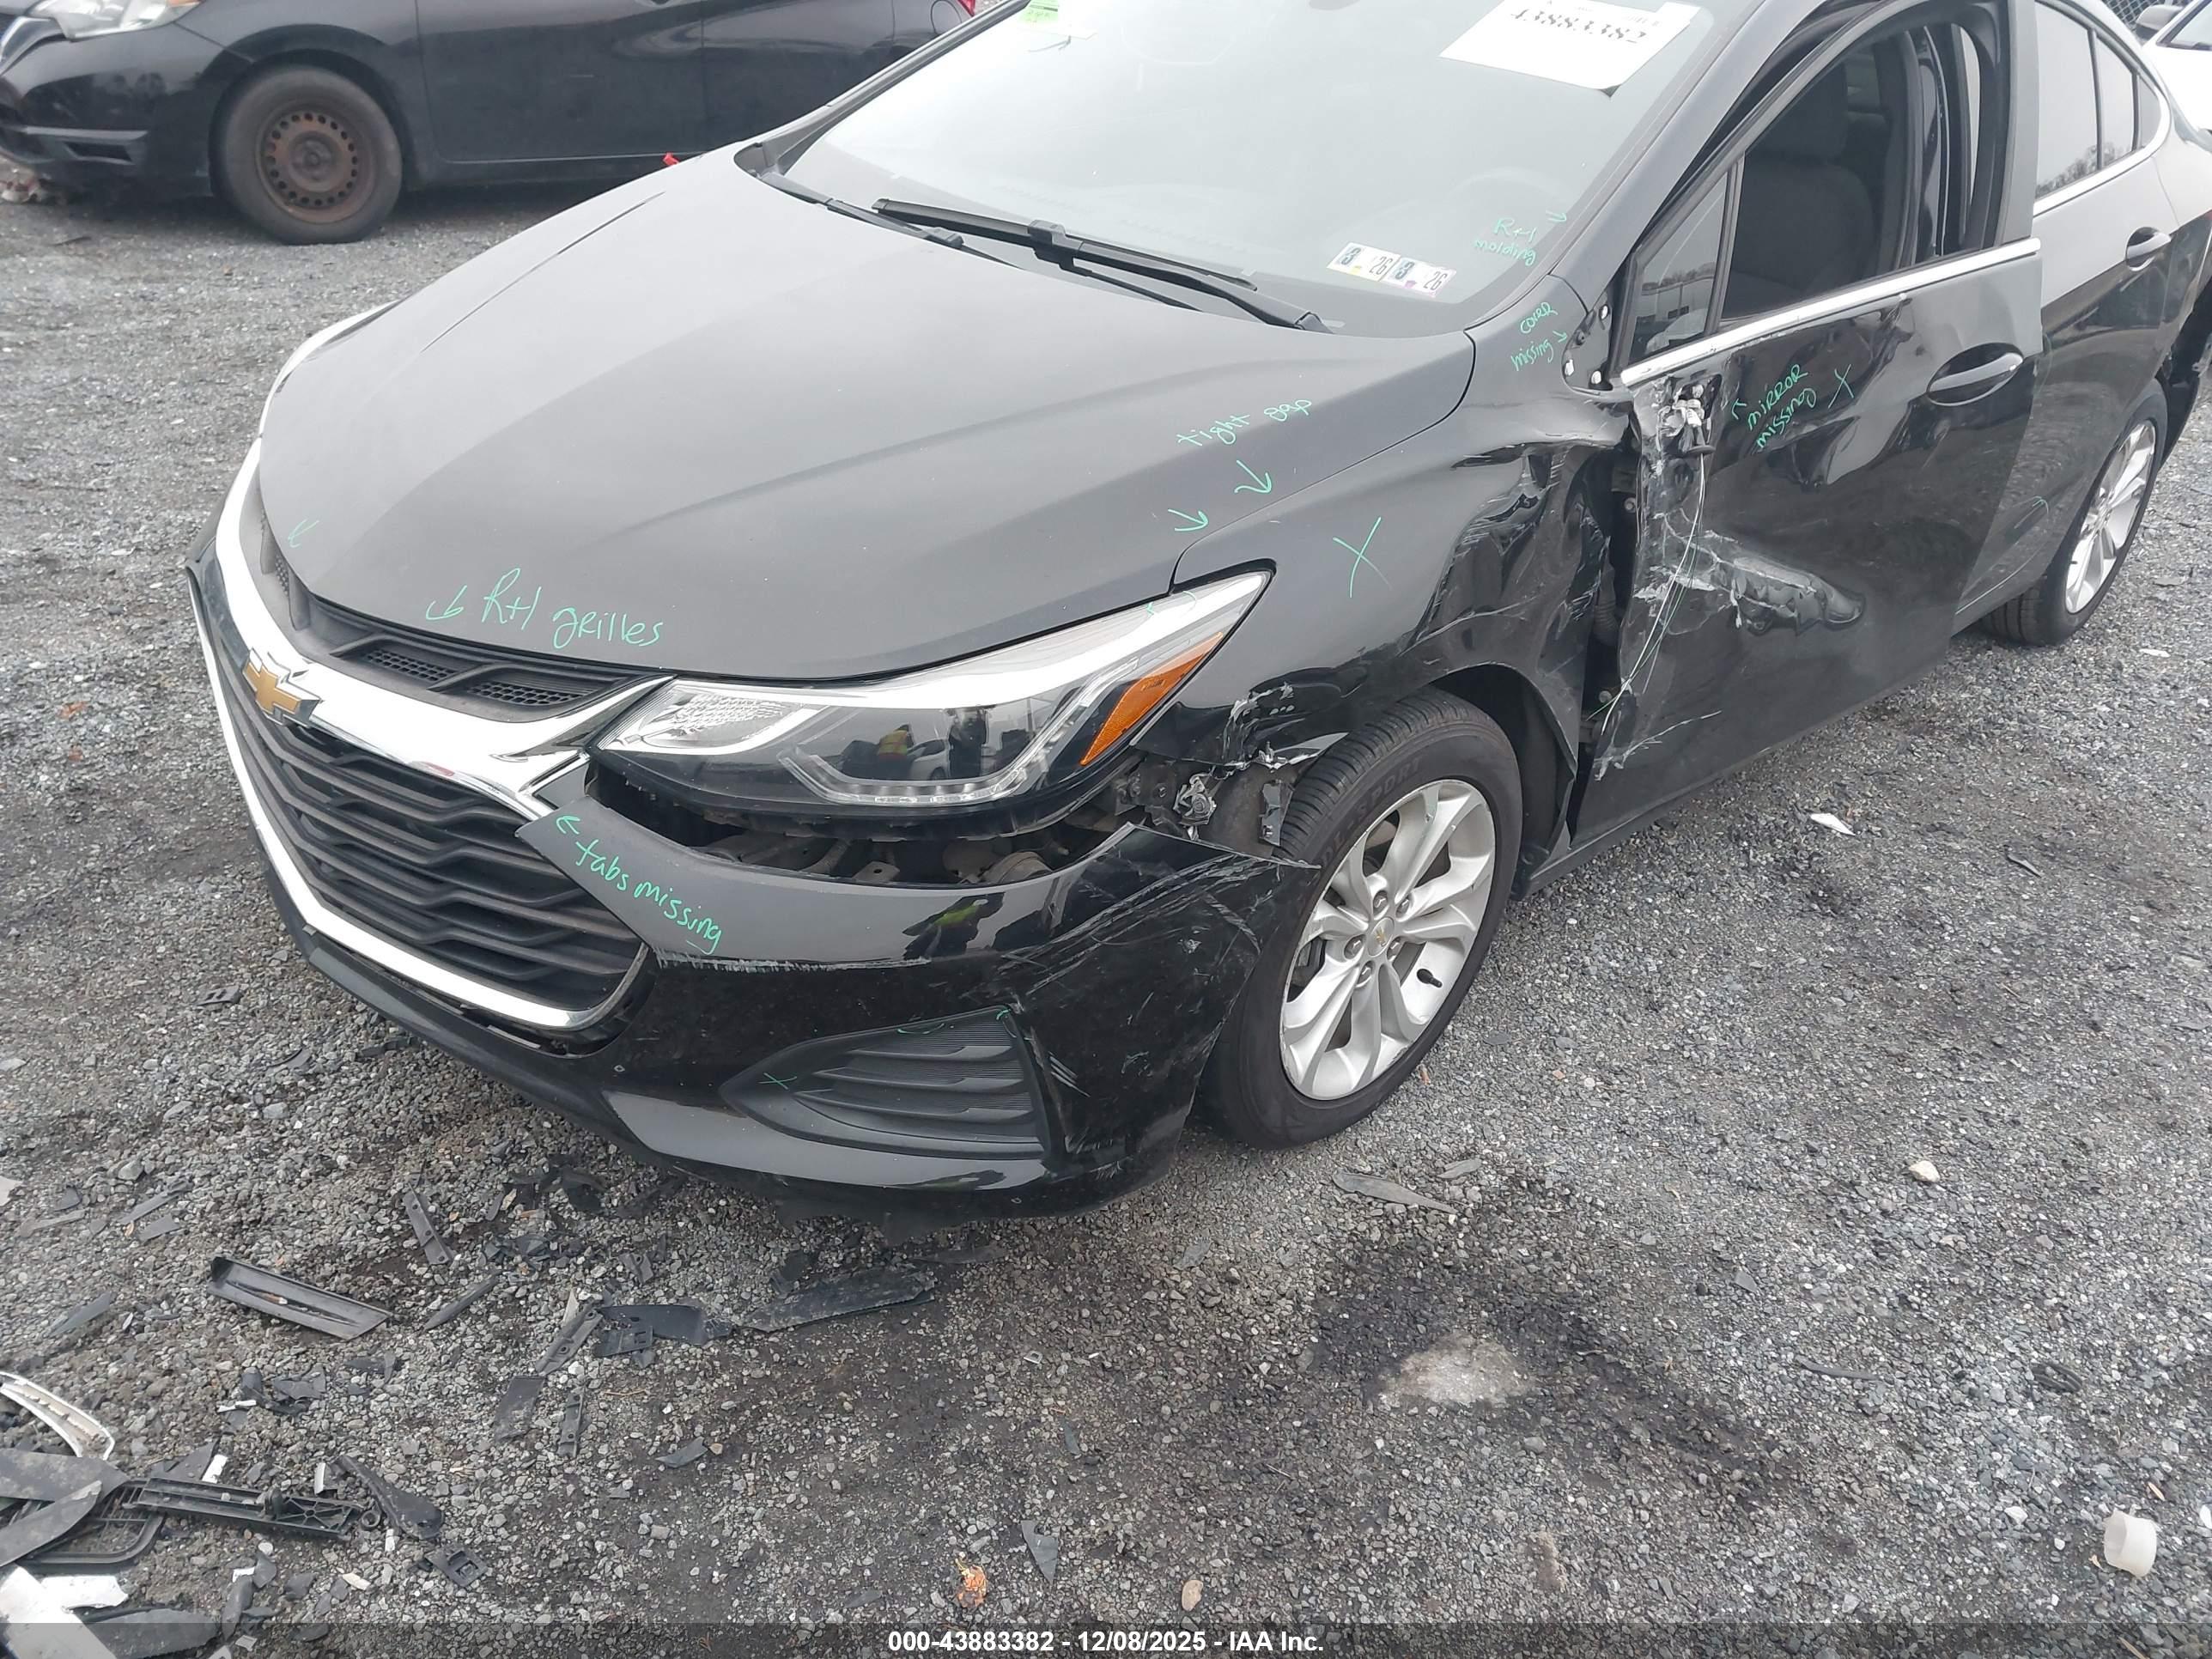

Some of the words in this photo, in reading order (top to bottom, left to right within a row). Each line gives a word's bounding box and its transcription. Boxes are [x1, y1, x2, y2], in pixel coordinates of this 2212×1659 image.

[1369, 256, 1394, 276] 26
[1474, 239, 1536, 266] molding
[1423, 270, 1449, 291] 26
[1510, 339, 1554, 371] missing
[1176, 414, 1250, 445] tight
[1263, 398, 1313, 422] gap
[1756, 387, 1817, 449] missing
[575, 838, 629, 892] tabs
[634, 880, 722, 956] missing
